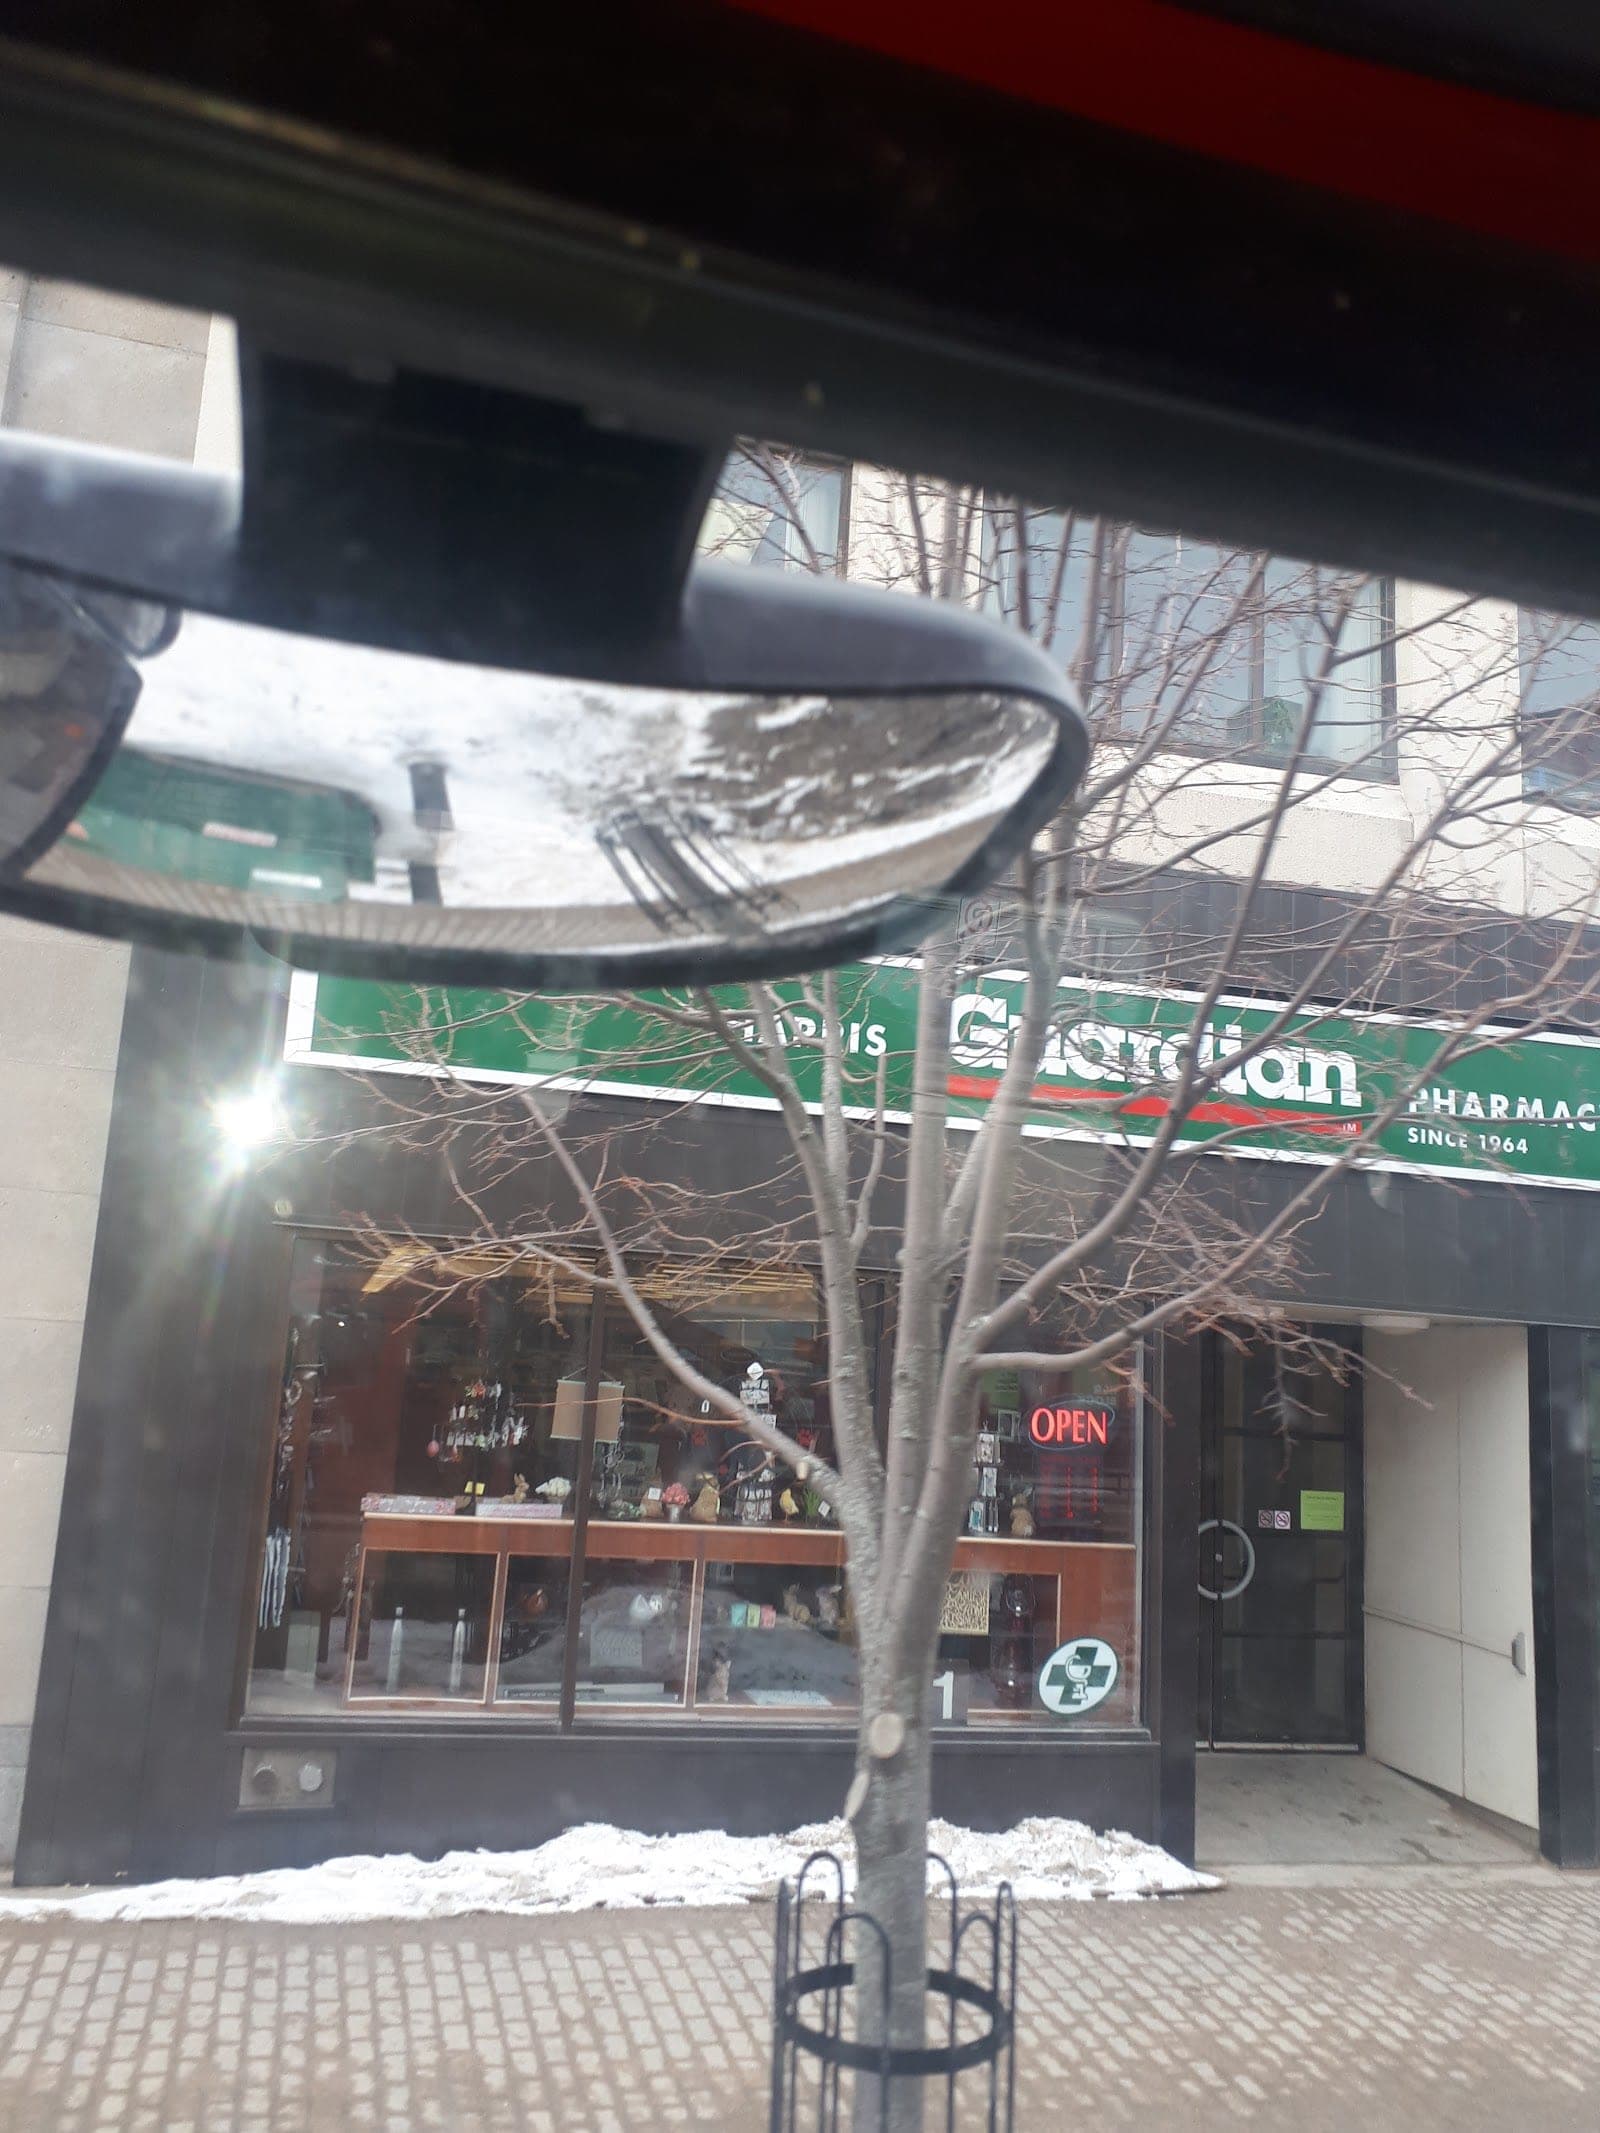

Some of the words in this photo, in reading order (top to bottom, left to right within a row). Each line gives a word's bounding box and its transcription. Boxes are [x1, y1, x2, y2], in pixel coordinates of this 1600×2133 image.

[1408, 1086, 1600, 1132] PHARMAC
[1408, 1126, 1468, 1149] SINCE
[1480, 1134, 1529, 1154] 1964
[1031, 1408, 1107, 1445] OPEN
[932, 1671, 954, 1719] 1
